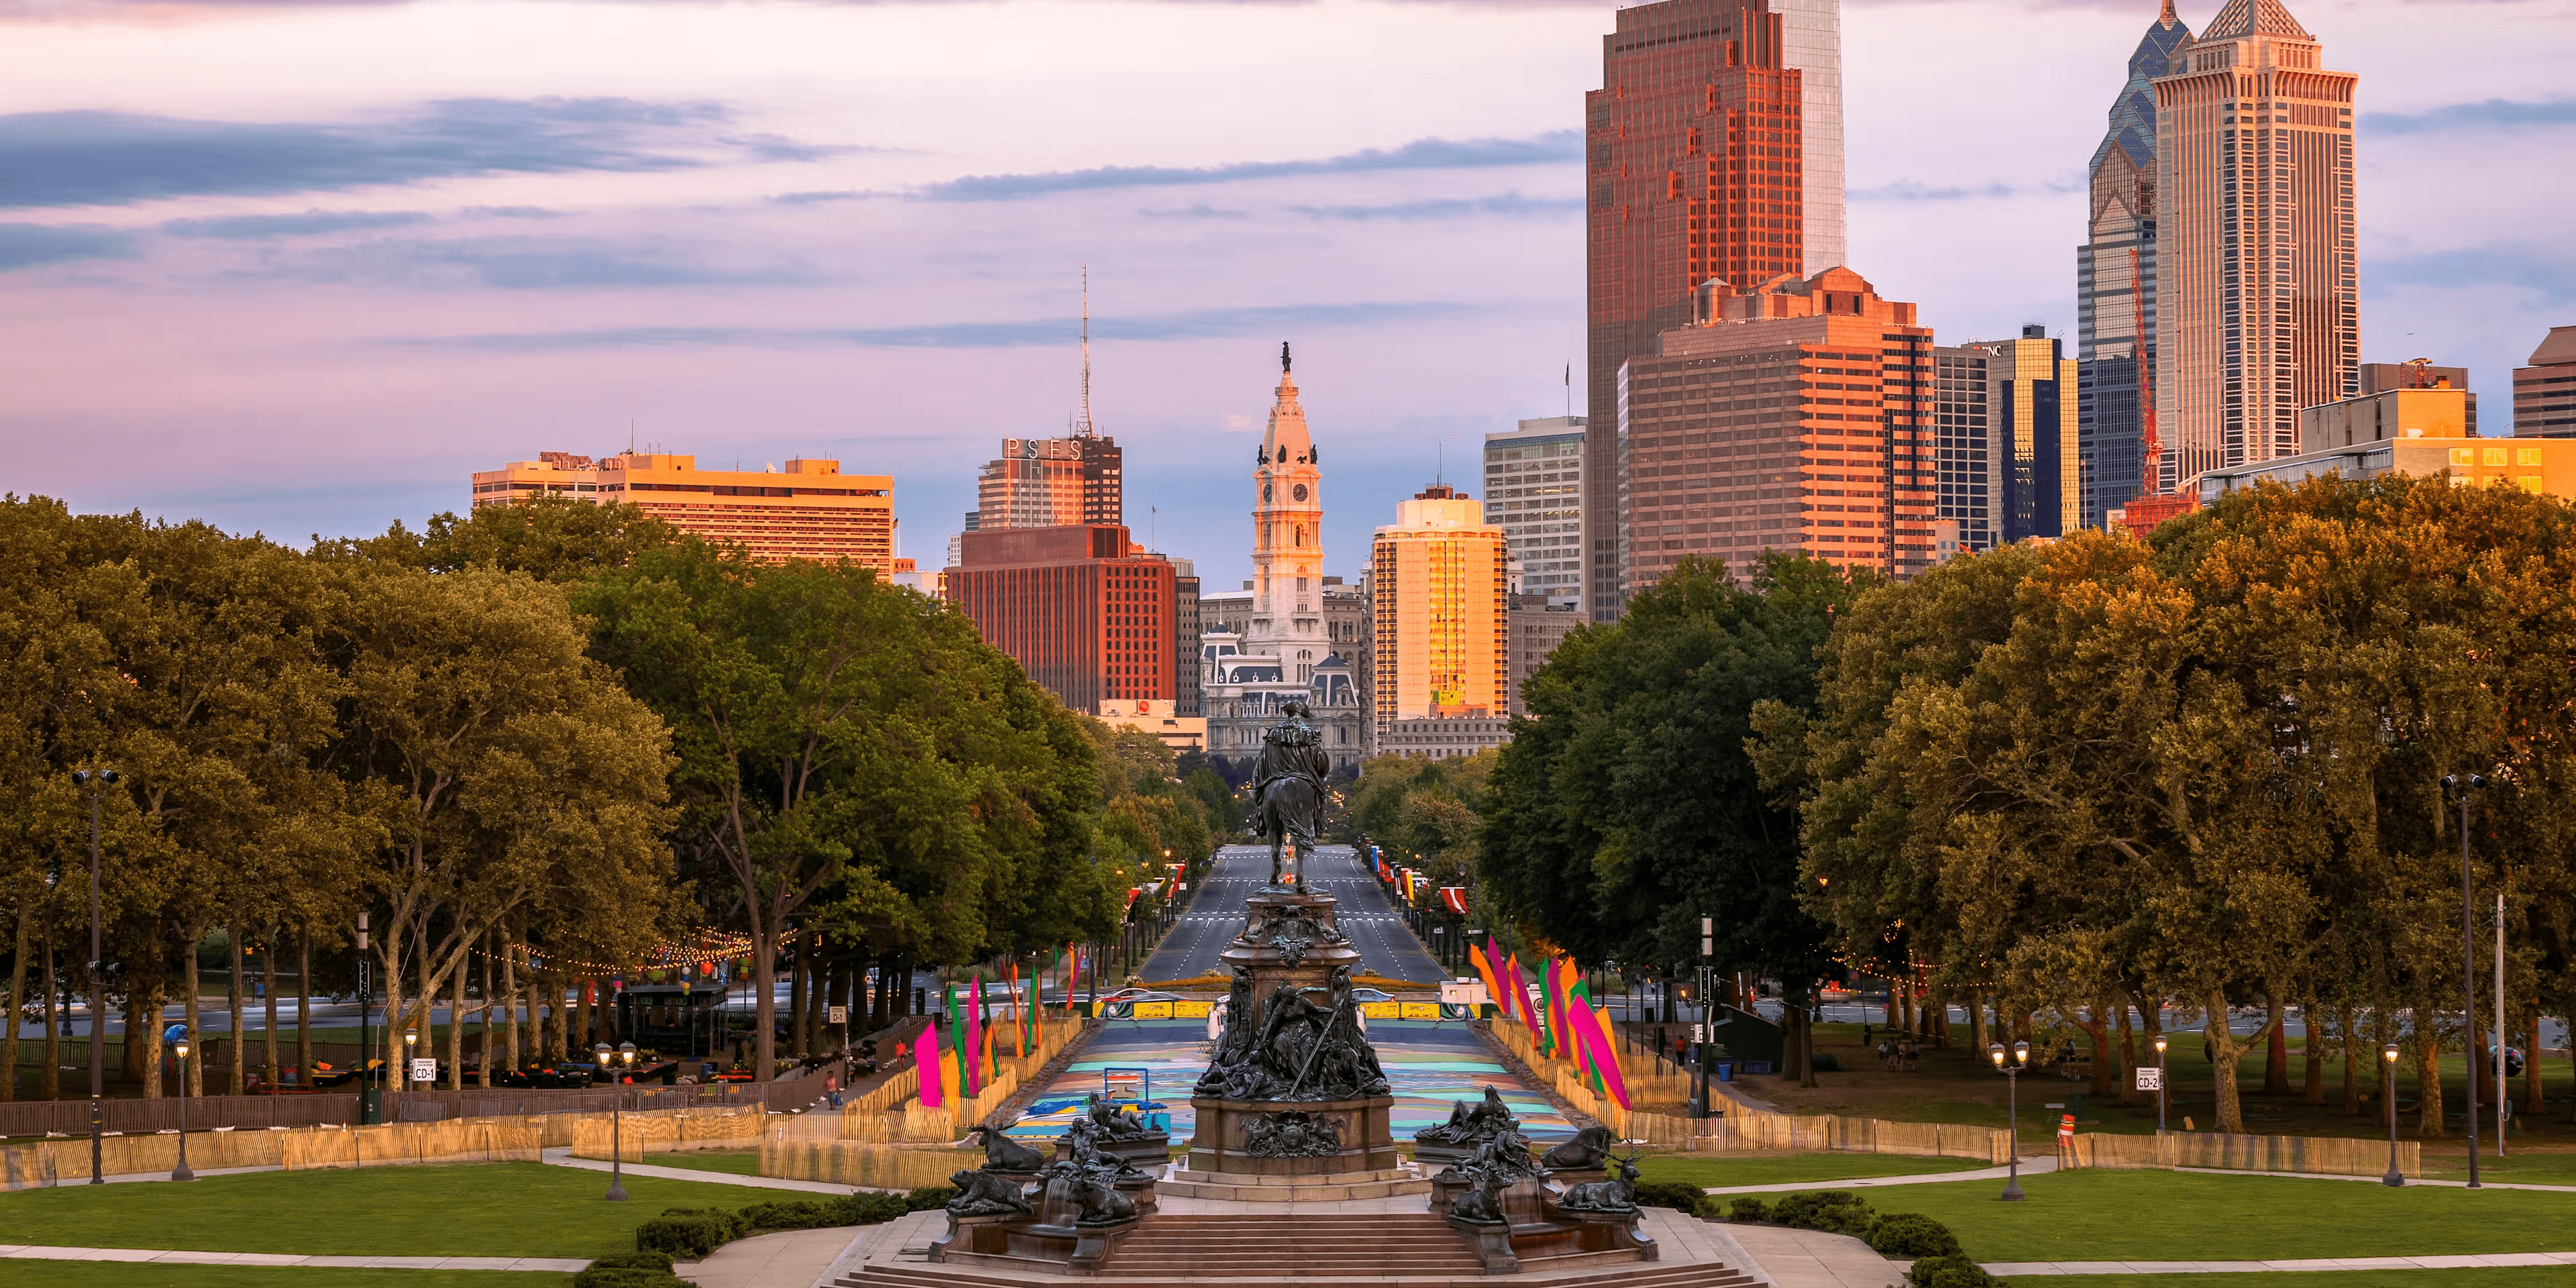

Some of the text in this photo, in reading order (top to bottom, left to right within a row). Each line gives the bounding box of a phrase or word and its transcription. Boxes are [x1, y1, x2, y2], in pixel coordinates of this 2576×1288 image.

[1982, 345, 2001, 356] NC
[1008, 438, 1081, 461] PSFS
[833, 1014, 843, 1022] D-1
[416, 1069, 434, 1079] CD-1
[2138, 1077, 2157, 1088] CD-2
